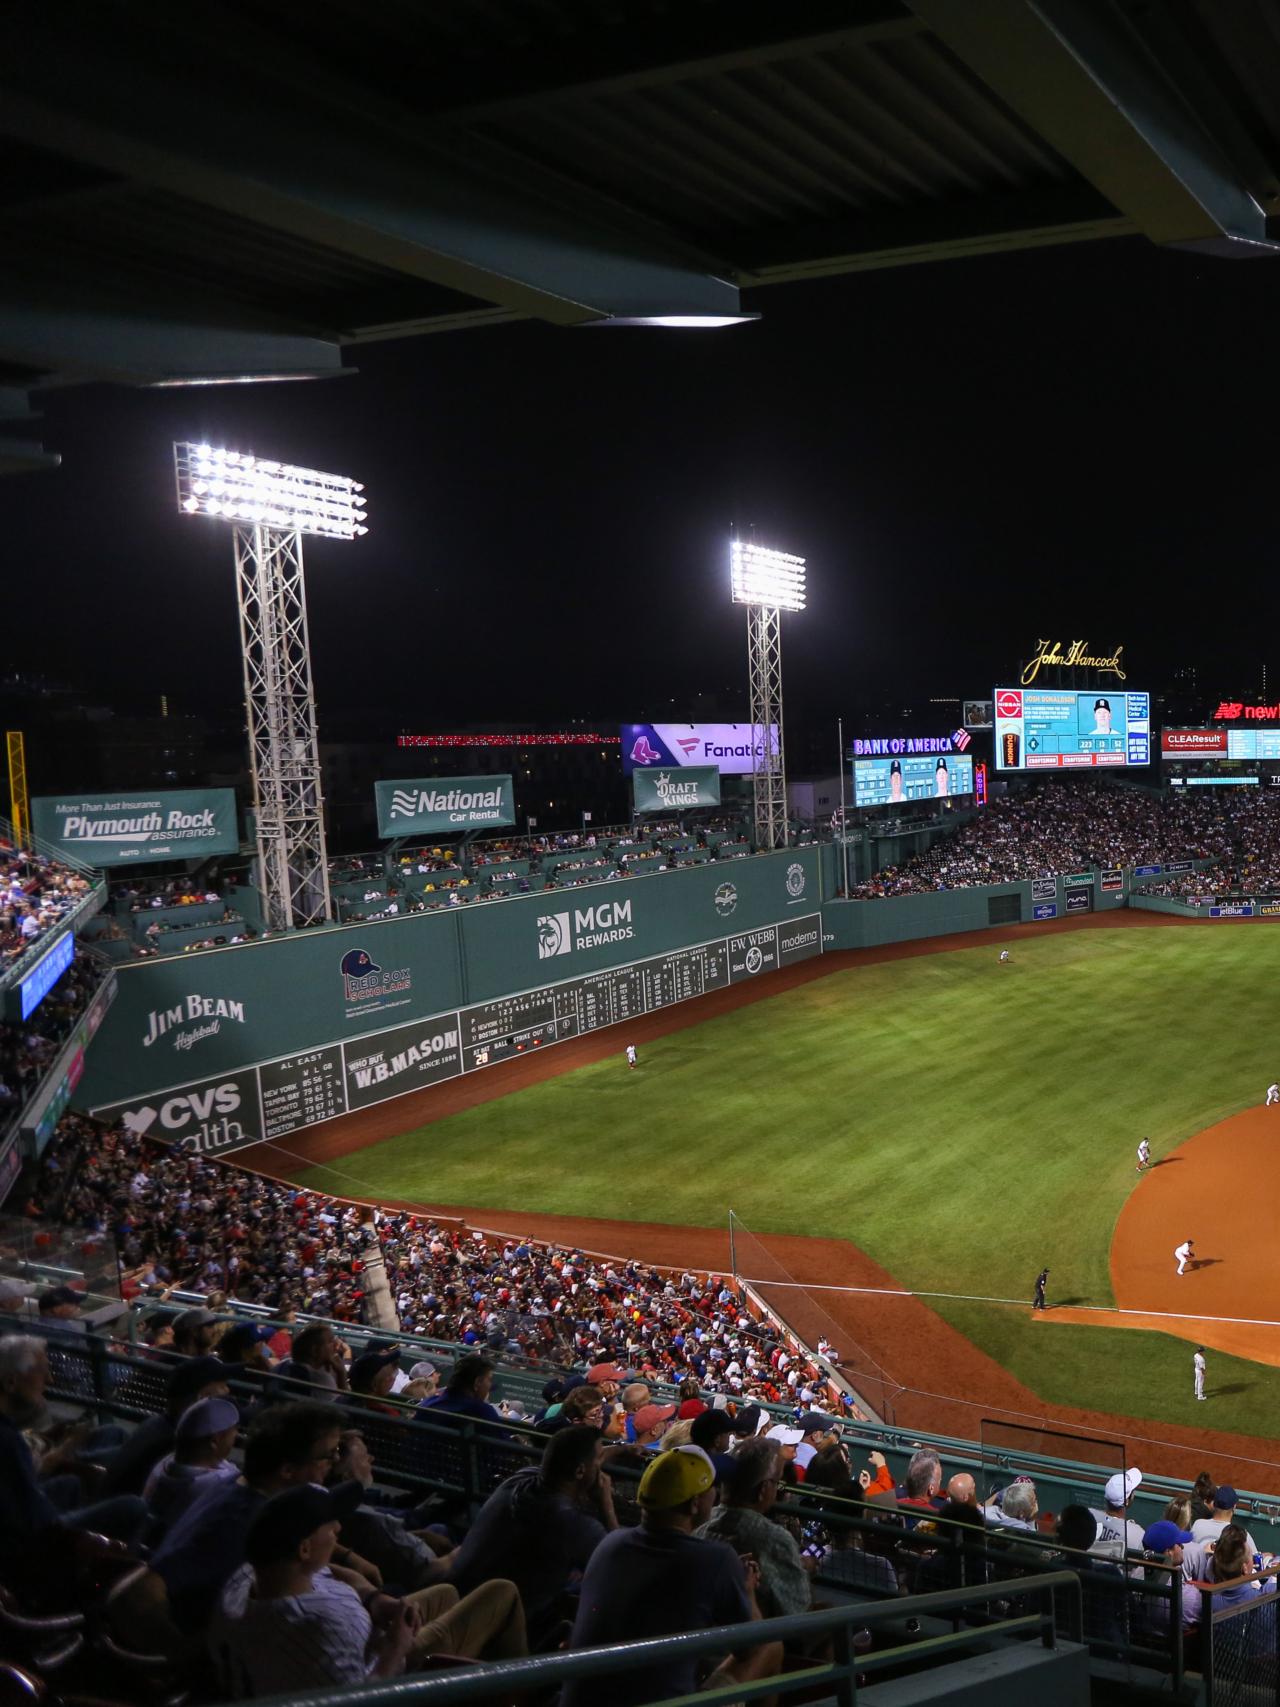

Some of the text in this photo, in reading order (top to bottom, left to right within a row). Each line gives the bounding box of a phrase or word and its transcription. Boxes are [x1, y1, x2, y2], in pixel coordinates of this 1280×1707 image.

[1021, 639, 1126, 685] John Hancock
[1245, 707, 1277, 719] new
[854, 738, 952, 754] BANK OF AMERICA
[657, 782, 698, 798] DRAFT
[56, 801, 162, 813] More Than Just Insurance.
[418, 787, 502, 813] National
[664, 794, 698, 806] KINGS
[63, 809, 215, 838] Plymouth Rock
[450, 810, 500, 822] Car Rental
[151, 826, 216, 841] assurance
[575, 899, 632, 934] MGM
[1220, 907, 1243, 915] jetBlue
[576, 927, 633, 950] REWARDS
[749, 929, 775, 946] WEBB
[782, 931, 817, 949] moderna
[666, 947, 707, 962] NATIONAL LEAGUE
[584, 967, 633, 985] AMERICAN LEAGUE
[732, 963, 745, 972] Since
[350, 968, 410, 991] RED SOX
[350, 980, 411, 1002] SCHOLARS
[485, 989, 554, 1013] FENWAY PARK
[143, 994, 245, 1046] JIM BEAM
[173, 1019, 220, 1050] Highball
[478, 1028, 498, 1040] BOSTON
[494, 1040, 508, 1049] BALL
[513, 1033, 530, 1043] STRIKE
[532, 1029, 543, 1037] OUT
[281, 1053, 323, 1070] AL EAST
[348, 1054, 384, 1072] WHO BUT
[419, 1059, 440, 1071] SINCE
[476, 1052, 489, 1065] 28
[264, 1089, 278, 1098] NEW
[279, 1083, 297, 1093] YORK
[302, 1079, 312, 1087] 85
[264, 1096, 286, 1107] TAMPA
[287, 1092, 300, 1100] BAY
[303, 1088, 312, 1096] 79
[160, 1083, 241, 1129] CVS
[265, 1102, 298, 1117] TORONTO
[304, 1097, 313, 1105] 79
[266, 1110, 302, 1126] BALTIMORE
[305, 1106, 314, 1114] 73
[315, 1102, 324, 1110] 67
[267, 1121, 295, 1136] BOSTON
[317, 1111, 326, 1119] 72
